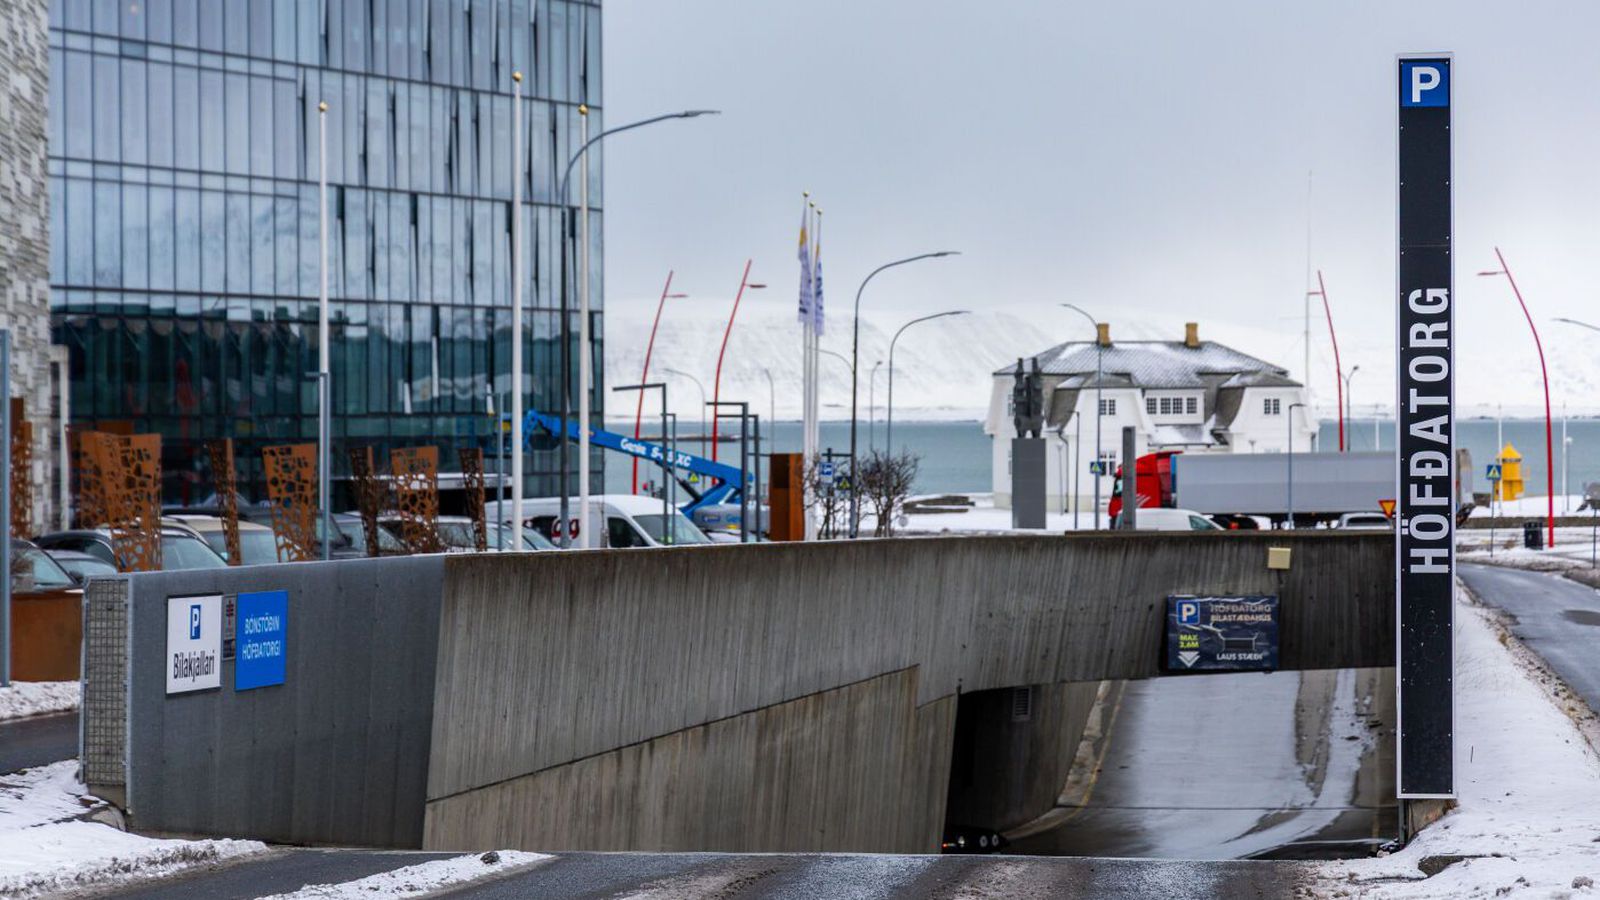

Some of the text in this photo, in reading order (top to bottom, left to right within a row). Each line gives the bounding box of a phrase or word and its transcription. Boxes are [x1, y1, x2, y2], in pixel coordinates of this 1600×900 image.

[1412, 66, 1440, 103] P
[1401, 287, 1449, 575] HÖFÐATORG
[191, 607, 200, 637] P
[1182, 604, 1196, 621] P
